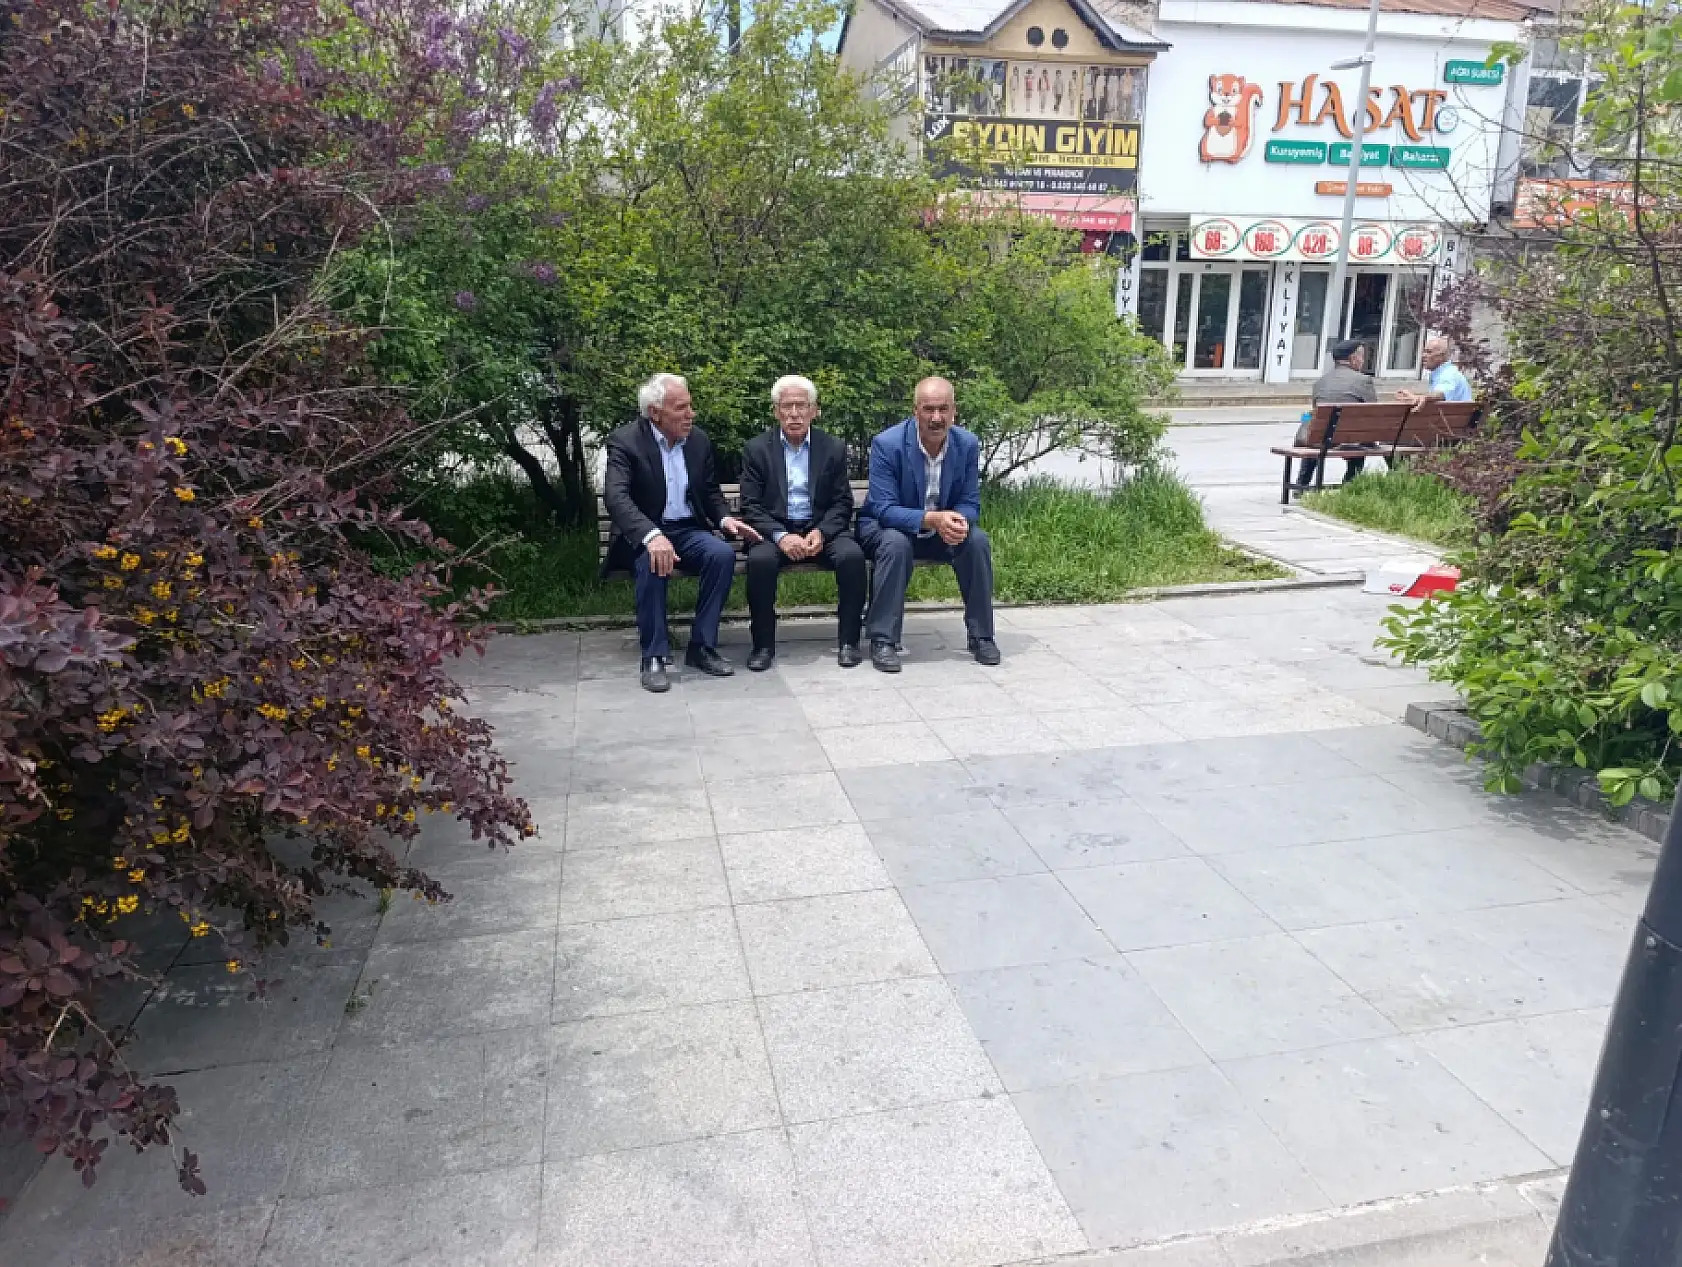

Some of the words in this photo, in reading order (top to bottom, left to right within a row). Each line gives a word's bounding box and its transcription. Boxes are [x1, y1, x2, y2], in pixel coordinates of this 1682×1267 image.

[1271, 73, 1448, 142] HASAT
[1056, 121, 1138, 155] GİYİM
[1271, 147, 1323, 159] Kuruyemiş
[1339, 149, 1380, 161] Bayat
